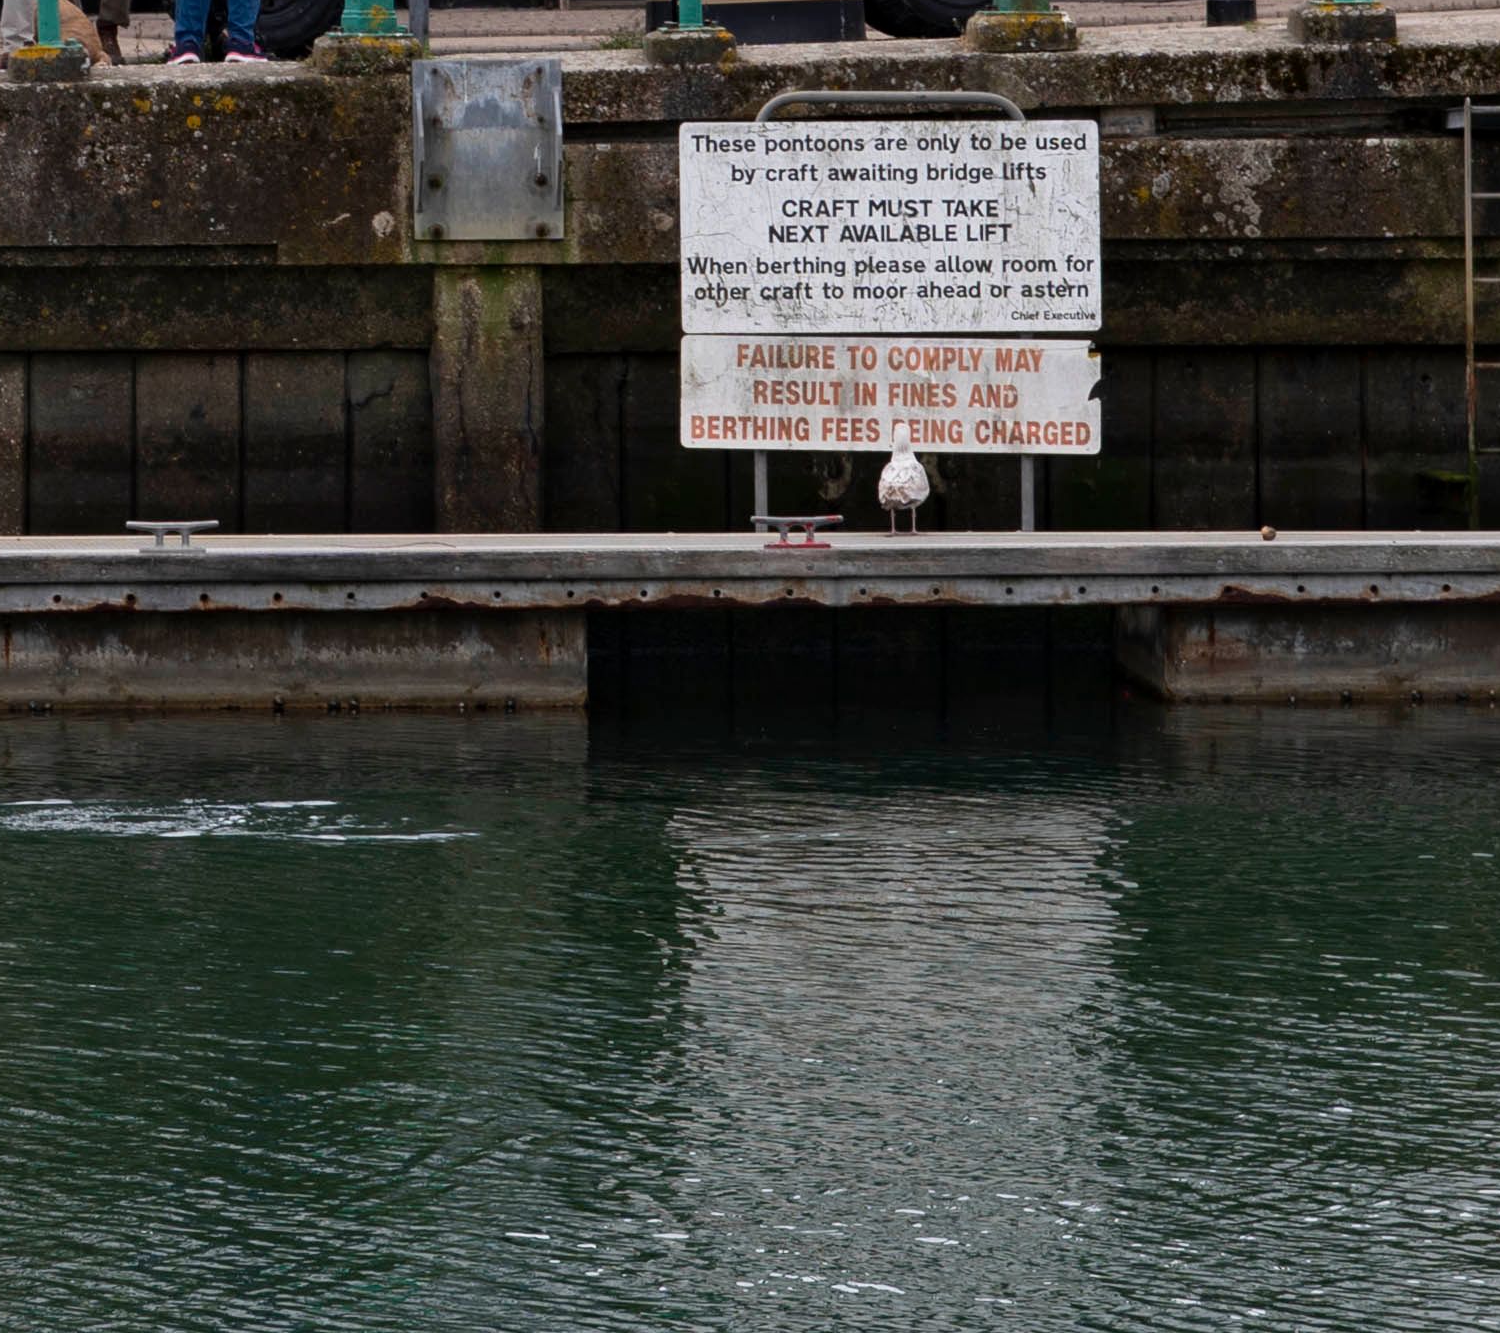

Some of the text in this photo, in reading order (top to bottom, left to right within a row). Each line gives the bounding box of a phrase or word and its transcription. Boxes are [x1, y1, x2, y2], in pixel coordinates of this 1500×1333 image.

[691, 134, 1086, 155] These pontoons are only to be used
[732, 162, 1046, 185] by craft awaiting bridge lifts
[782, 200, 998, 219] CRAFT MUST TAKE
[769, 224, 1012, 243] NEXT AVAILABLE LIFT
[687, 255, 1094, 278] When berthing please allow room for
[695, 280, 1088, 305] other craft to moor ahead or astern
[1011, 310, 1096, 320] Chief Executive
[738, 343, 1044, 372] FAILURE TO COMPLY MAY
[753, 381, 1018, 408] RESULT IN FINES AND
[692, 415, 1090, 445] BERTHING FEES EING CHARGED
